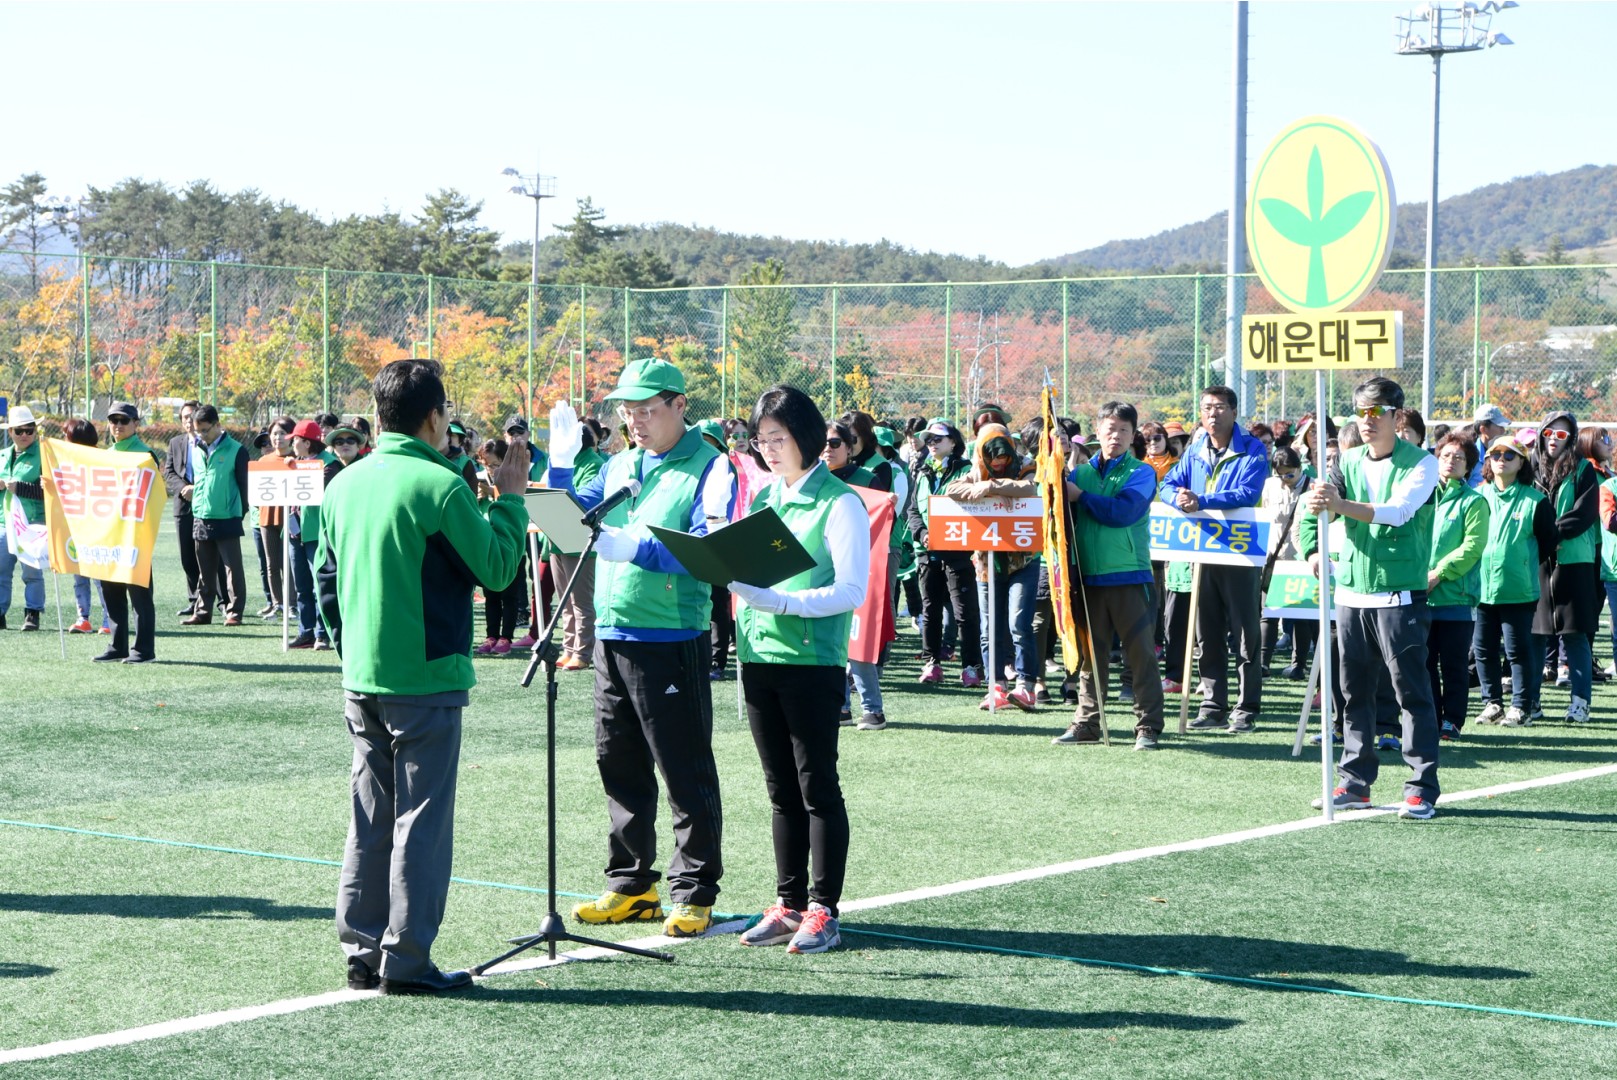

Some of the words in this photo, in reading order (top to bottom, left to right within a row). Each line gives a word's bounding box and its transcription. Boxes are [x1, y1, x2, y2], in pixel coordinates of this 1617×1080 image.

[1248, 319, 1389, 363] 해운대구
[257, 475, 315, 502] 중1동
[1150, 518, 1252, 553] 반여2동
